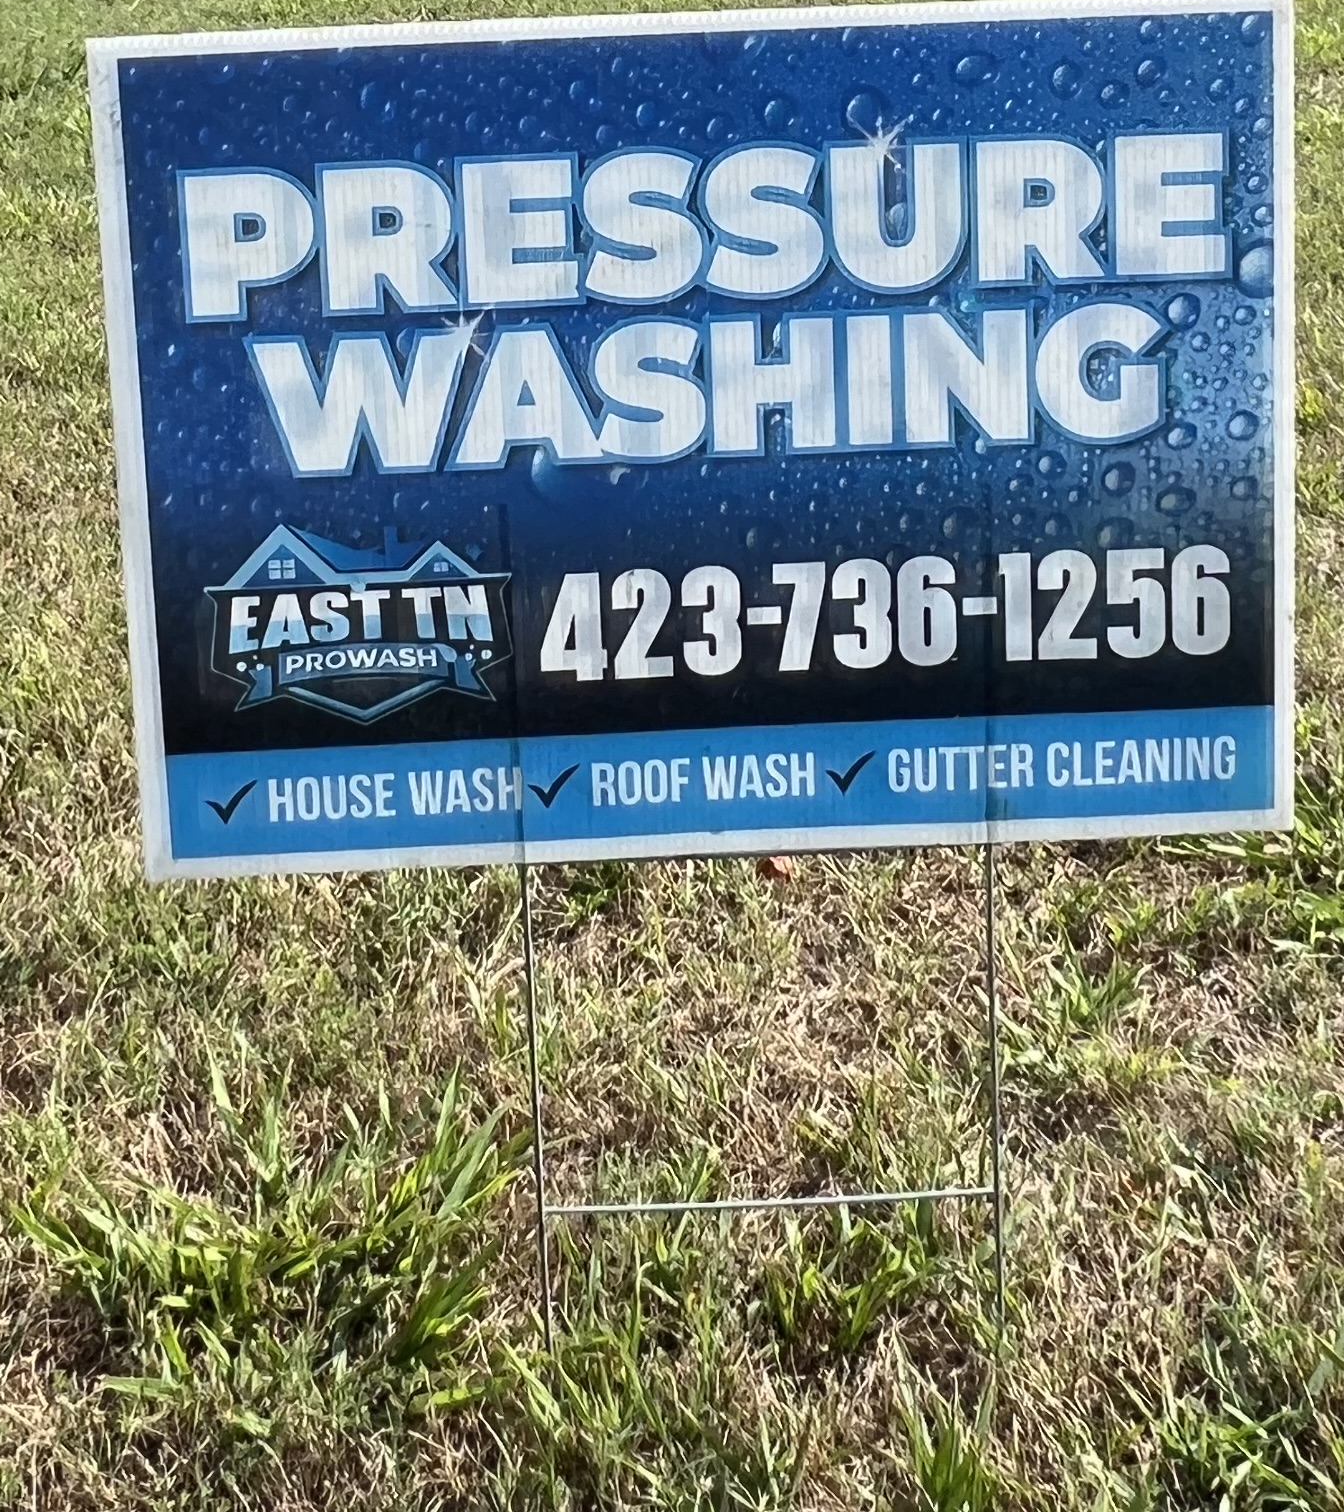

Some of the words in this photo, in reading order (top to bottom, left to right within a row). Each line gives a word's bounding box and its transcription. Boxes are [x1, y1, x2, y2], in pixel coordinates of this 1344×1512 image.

[179, 130, 1230, 323] PRESSURE
[248, 303, 1172, 478] WASHING
[229, 589, 390, 655] EAST
[402, 584, 494, 642] TN
[540, 544, 1231, 682] 423-736-1256
[286, 647, 438, 675] PROWASH
[267, 771, 397, 822] HOUSE
[408, 765, 523, 816] WASH
[591, 757, 691, 807] ROOF
[701, 751, 816, 803] WASH
[887, 742, 1035, 794] GUTTER
[1046, 735, 1237, 789] CLEANING
